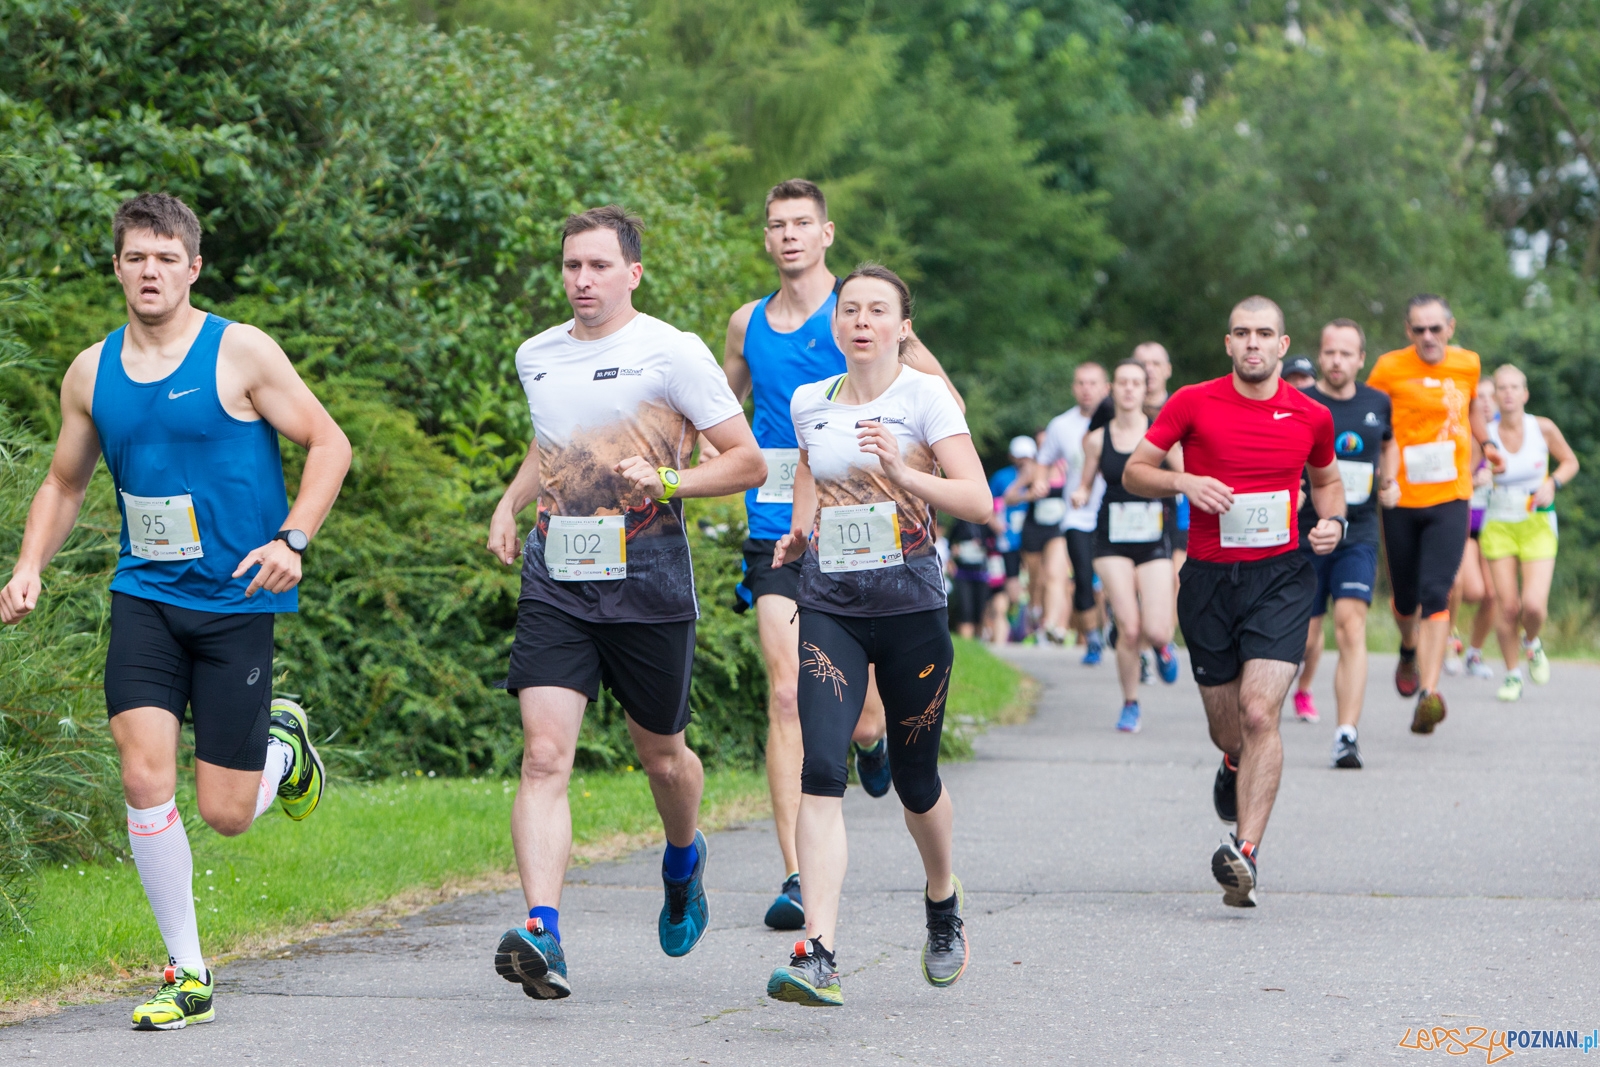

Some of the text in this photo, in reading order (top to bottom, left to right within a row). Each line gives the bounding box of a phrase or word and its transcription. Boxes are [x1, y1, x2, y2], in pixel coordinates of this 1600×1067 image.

[141, 514, 166, 535] 95
[1246, 507, 1269, 525] 78
[563, 533, 601, 554] 102
[837, 522, 871, 544] 101
[611, 566, 625, 574] mjp
